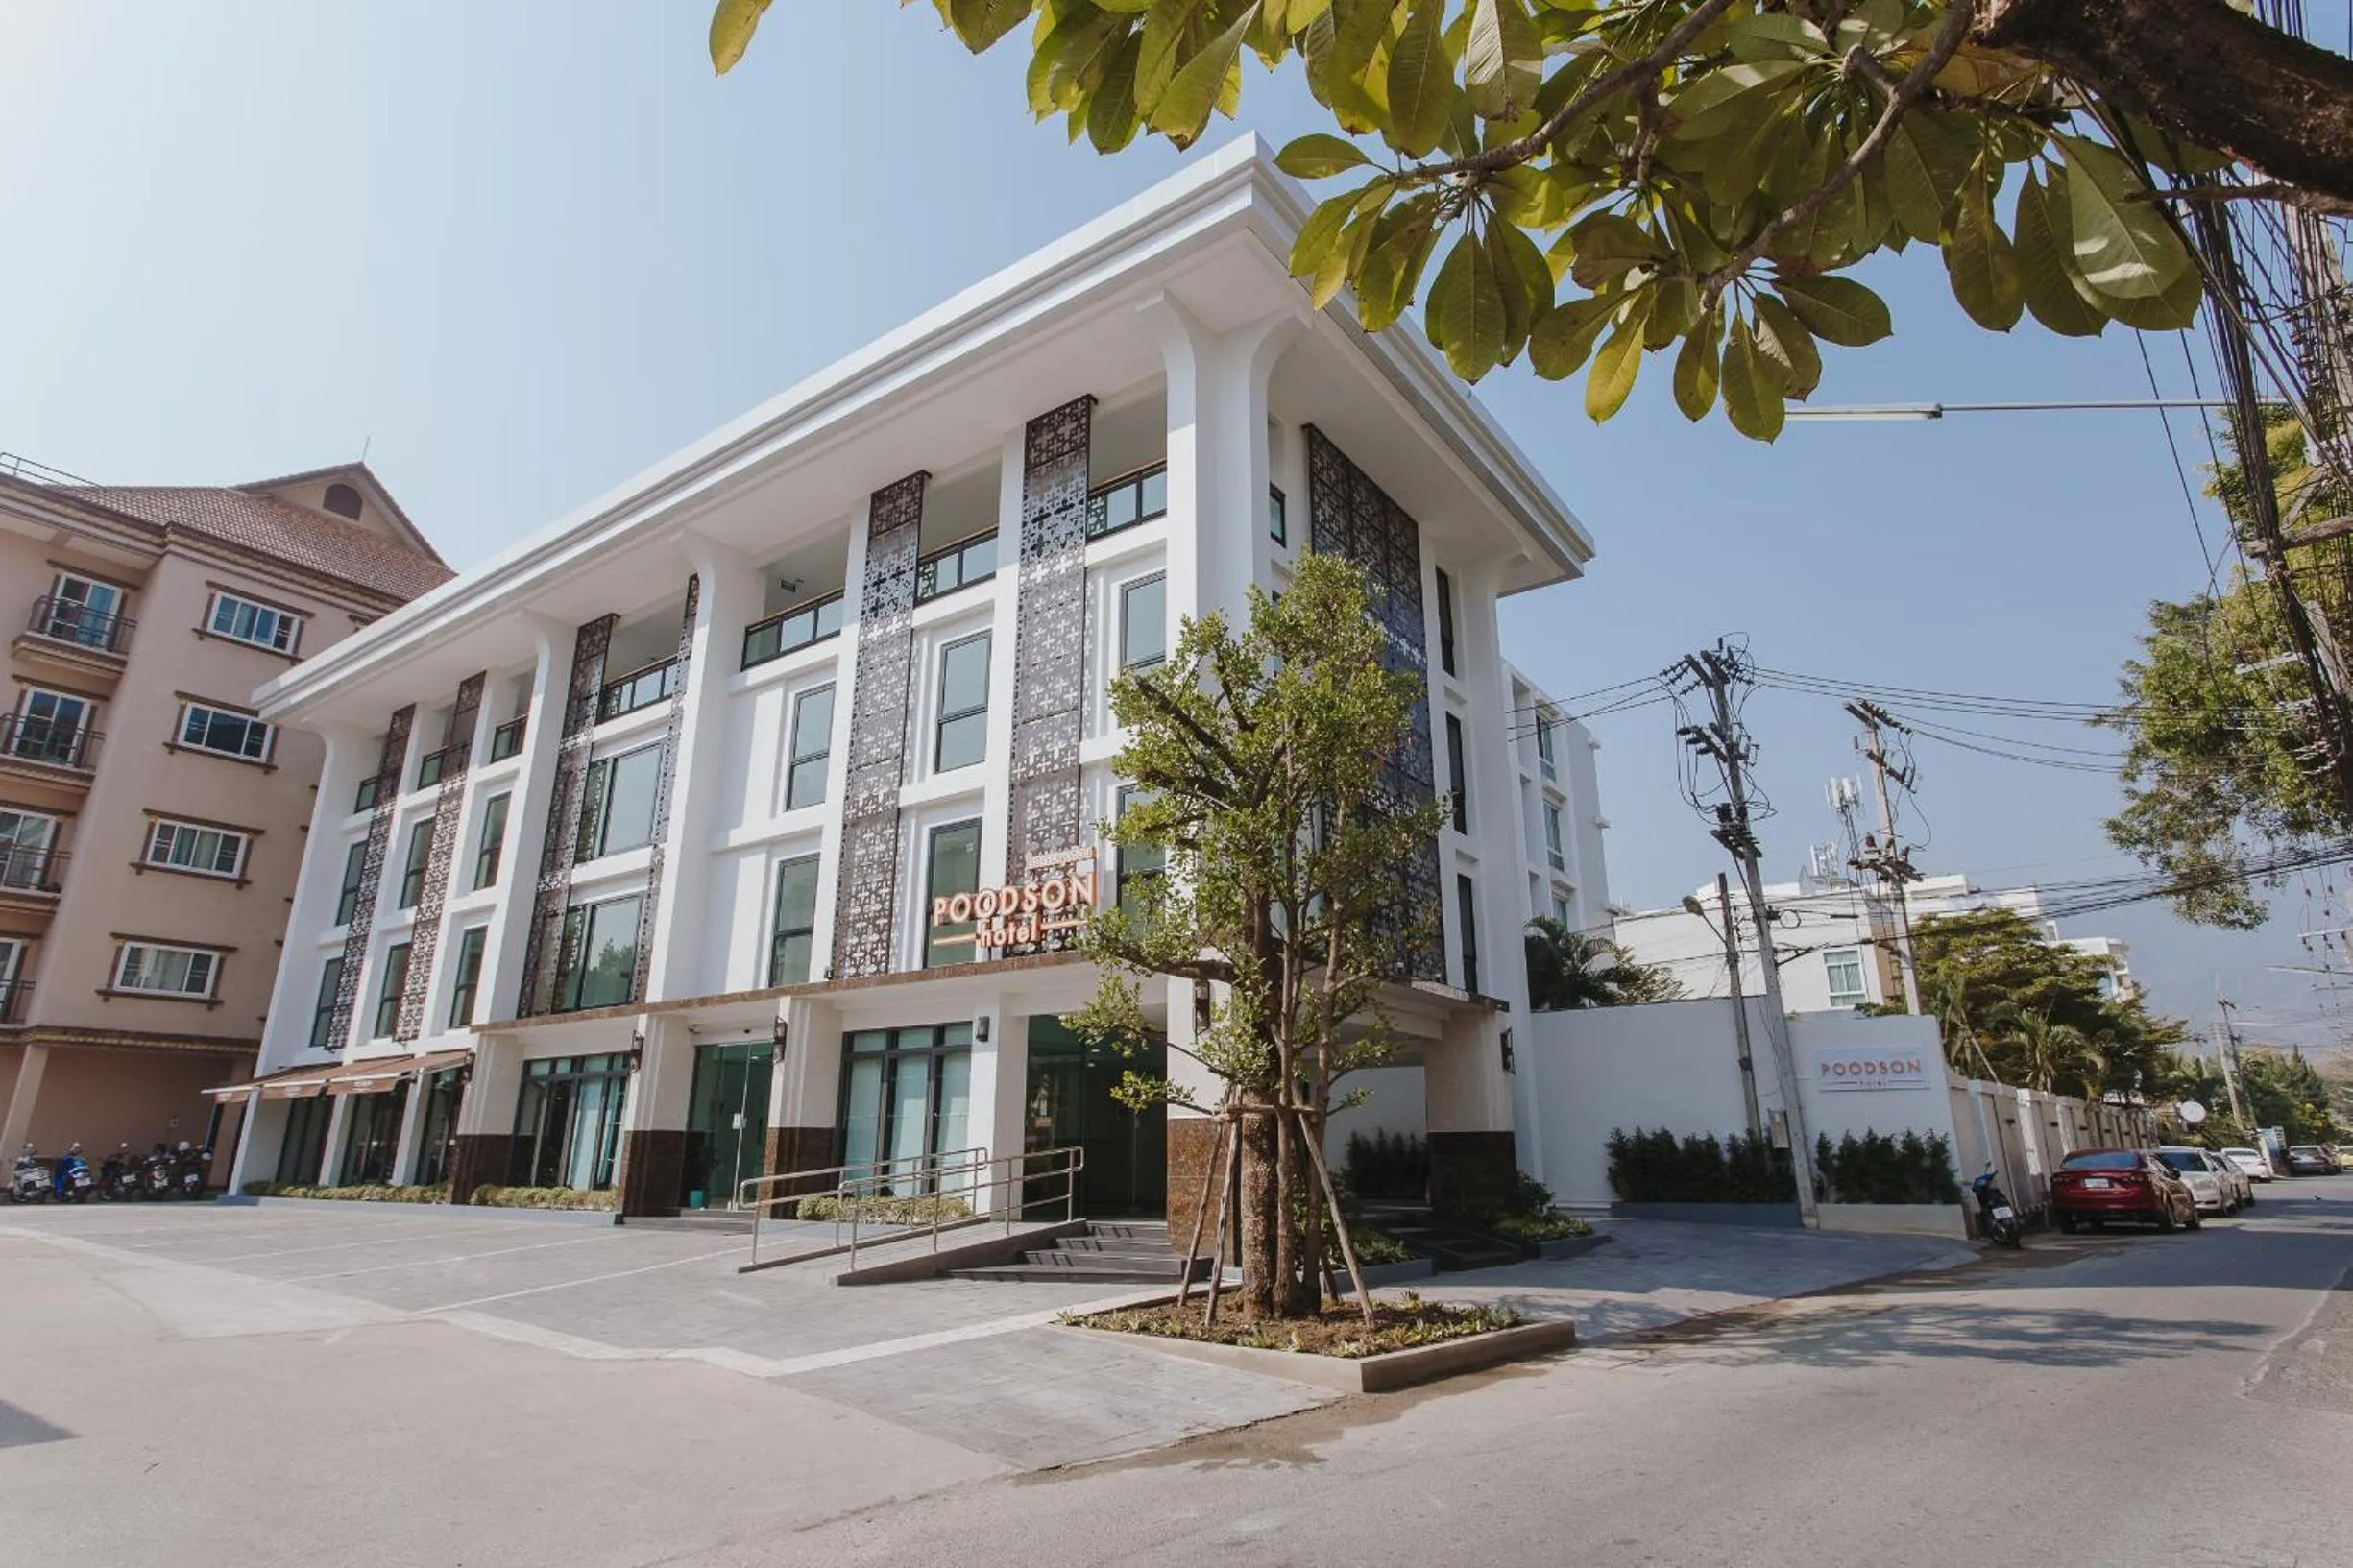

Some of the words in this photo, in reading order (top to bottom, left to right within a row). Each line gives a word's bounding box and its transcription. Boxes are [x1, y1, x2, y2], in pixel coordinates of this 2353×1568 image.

[934, 873, 1097, 928] POODSON
[980, 914, 1041, 948] hotel
[1821, 1059, 1921, 1076] POODSON
